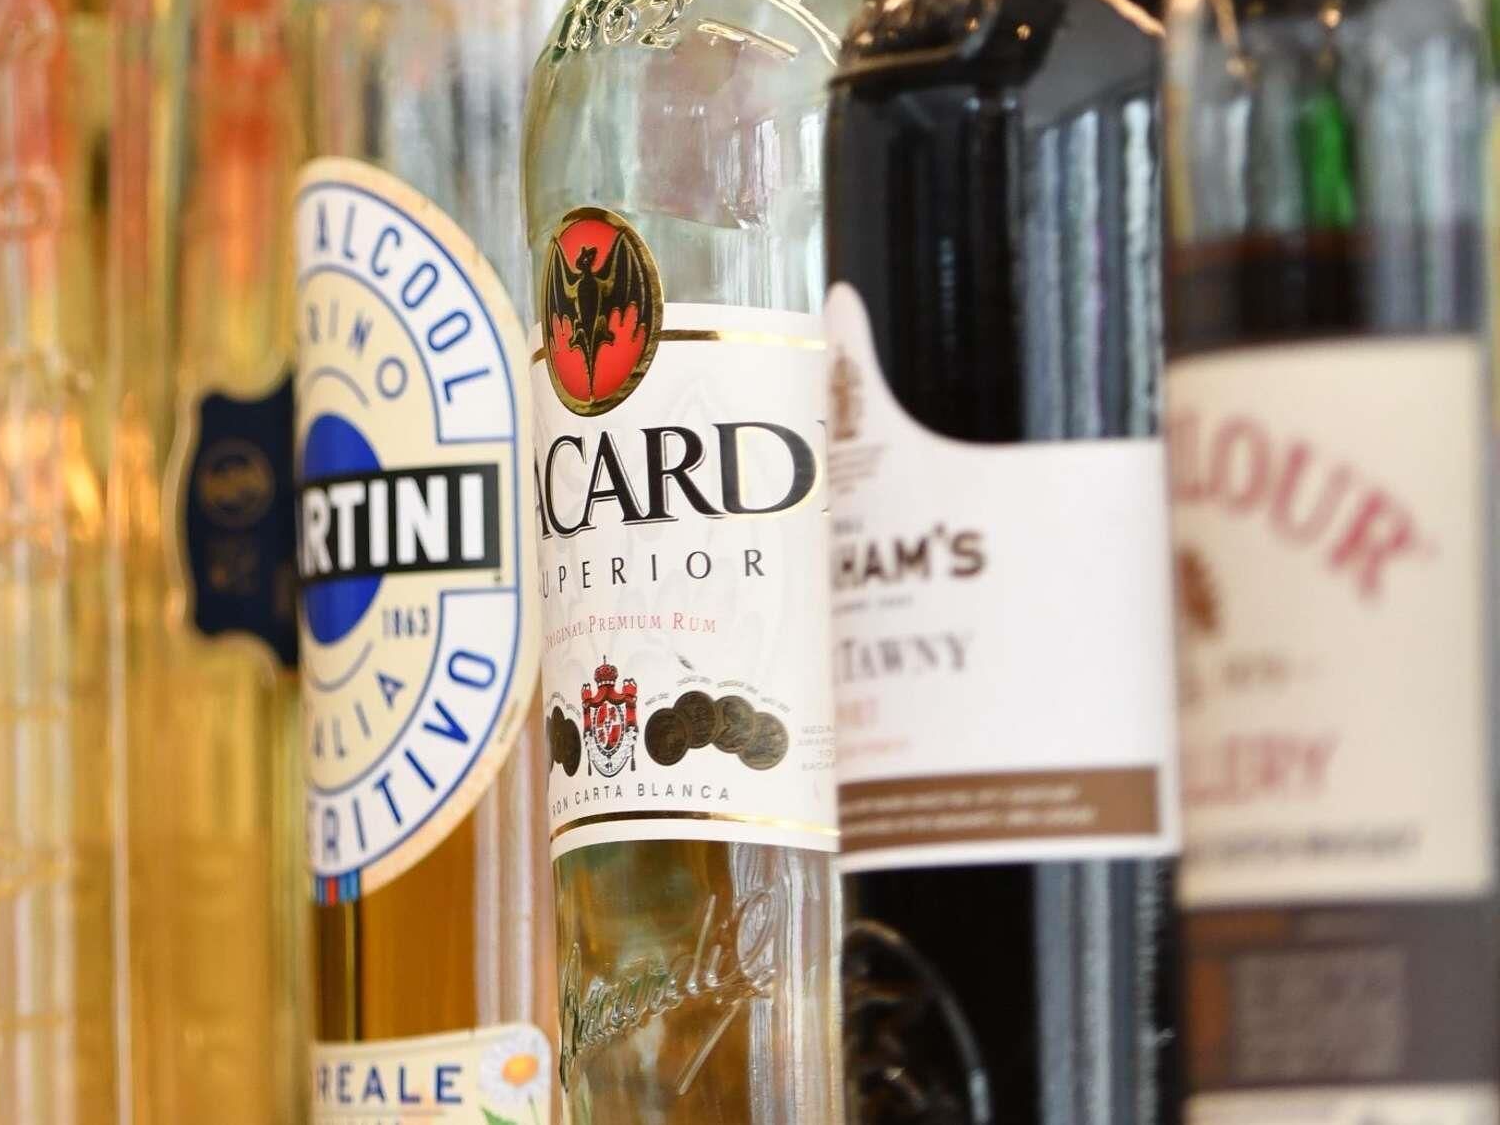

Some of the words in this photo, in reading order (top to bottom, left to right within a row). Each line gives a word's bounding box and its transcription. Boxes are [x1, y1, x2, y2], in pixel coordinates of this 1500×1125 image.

[315, 199, 492, 407] ALCOOL
[300, 473, 486, 576] RTINI
[534, 421, 822, 540] ACARD
[574, 783, 624, 806] CARTA
[636, 782, 731, 802] BLANCA
